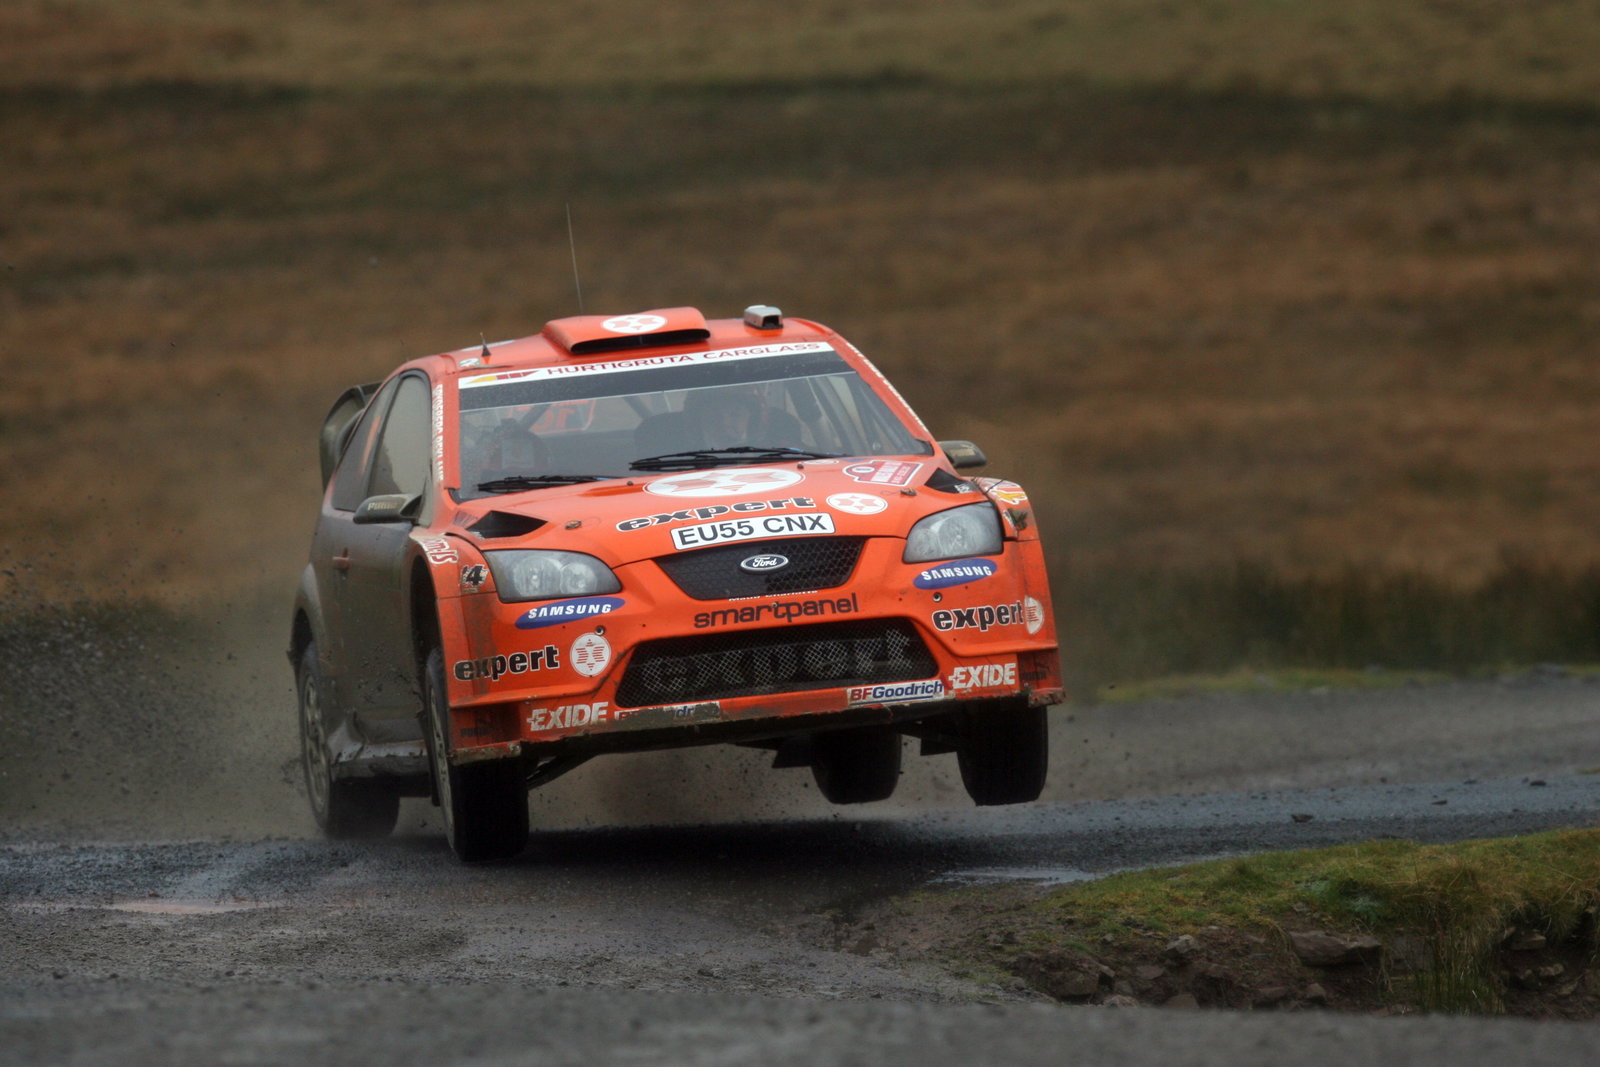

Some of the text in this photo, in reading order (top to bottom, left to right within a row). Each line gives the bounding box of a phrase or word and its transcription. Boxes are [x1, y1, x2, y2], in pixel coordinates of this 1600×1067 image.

[546, 343, 820, 375] HURTIGRUTA CARGLASS
[616, 497, 816, 531] expert
[678, 515, 828, 546] EU55 CNX
[752, 556, 778, 568] Ford
[921, 565, 992, 581] SAMSUNG
[528, 603, 612, 619] SAMSUNG
[694, 592, 859, 629] smartpanel
[931, 600, 1024, 632] expert
[454, 645, 559, 682] expert
[948, 662, 1017, 690] EXIDE
[850, 681, 944, 701] BFGoodrich
[527, 702, 609, 733] EXIDE
